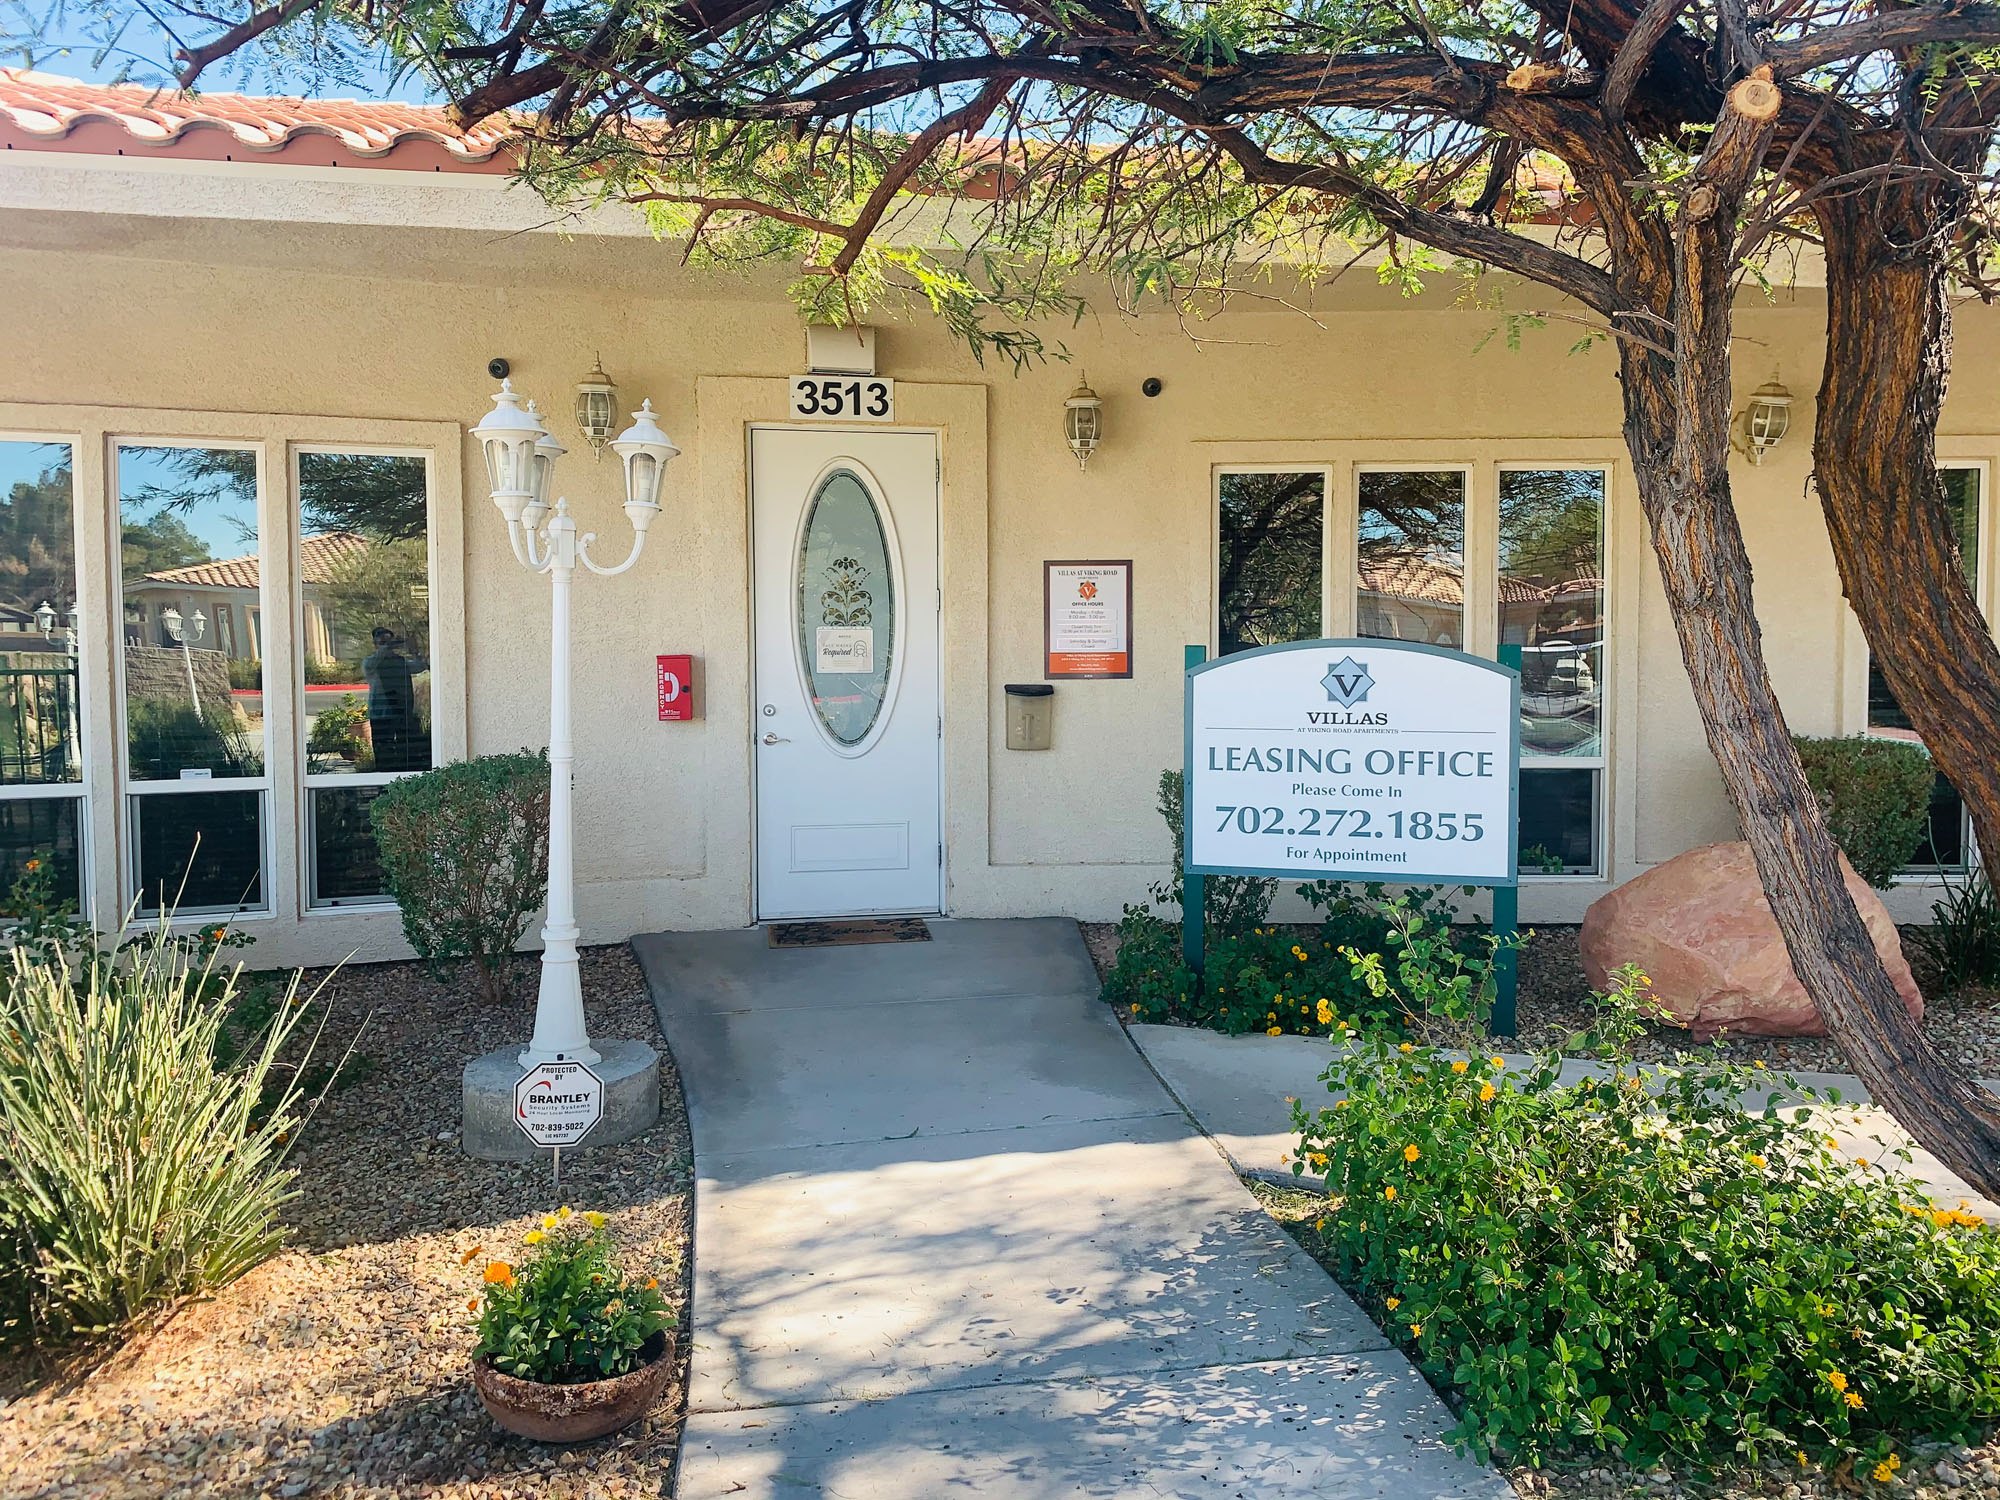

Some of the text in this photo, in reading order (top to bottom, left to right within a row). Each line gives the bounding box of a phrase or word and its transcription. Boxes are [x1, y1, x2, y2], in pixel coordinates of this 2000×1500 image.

[797, 380, 889, 416] 3513
[1084, 586, 1092, 596] V
[823, 648, 852, 658] Required
[1332, 674, 1364, 698] V
[1306, 711, 1388, 726] VILLAS
[1333, 727, 1352, 735] ROAD
[1208, 747, 1493, 777] LEASING OFFICE
[1292, 783, 1402, 798] Please Come In
[1215, 806, 1484, 842] 702.272.1855
[1286, 846, 1407, 864] For Appointment
[530, 1092, 590, 1104] BRANTLEY
[531, 1121, 584, 1131] 702-839-5022
